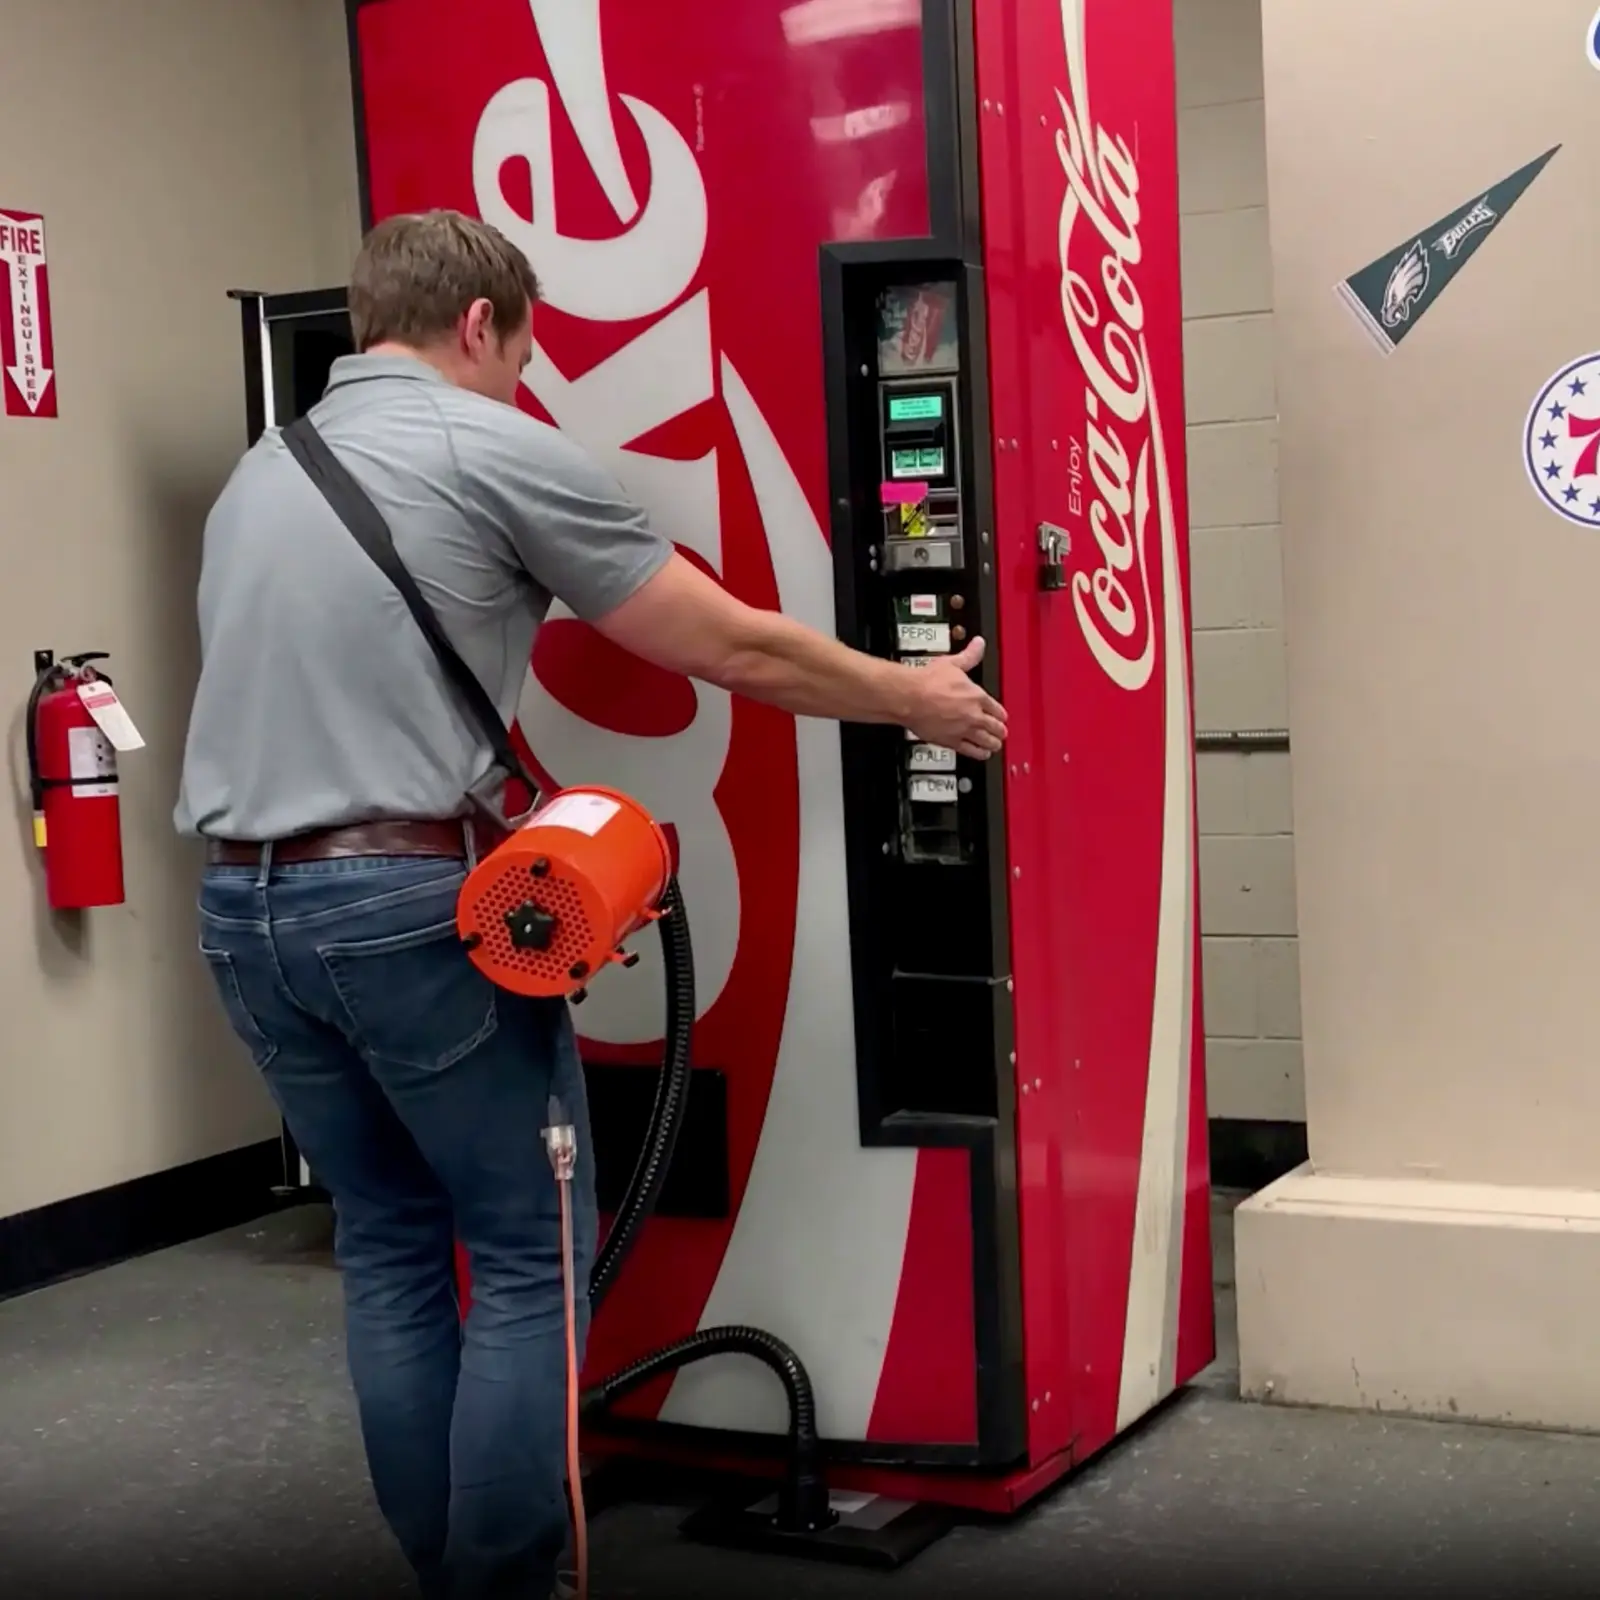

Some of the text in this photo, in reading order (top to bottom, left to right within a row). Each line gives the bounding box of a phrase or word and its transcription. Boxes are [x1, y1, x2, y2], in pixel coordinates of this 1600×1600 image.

[0, 225, 41, 255] FIRE
[1434, 197, 1497, 259] EAGLES
[17, 255, 38, 402] EXTINGUISHER
[1055, 90, 1155, 691] Coca-Cola
[1068, 433, 1082, 516] Enjoy
[901, 626, 937, 641] PEPSI
